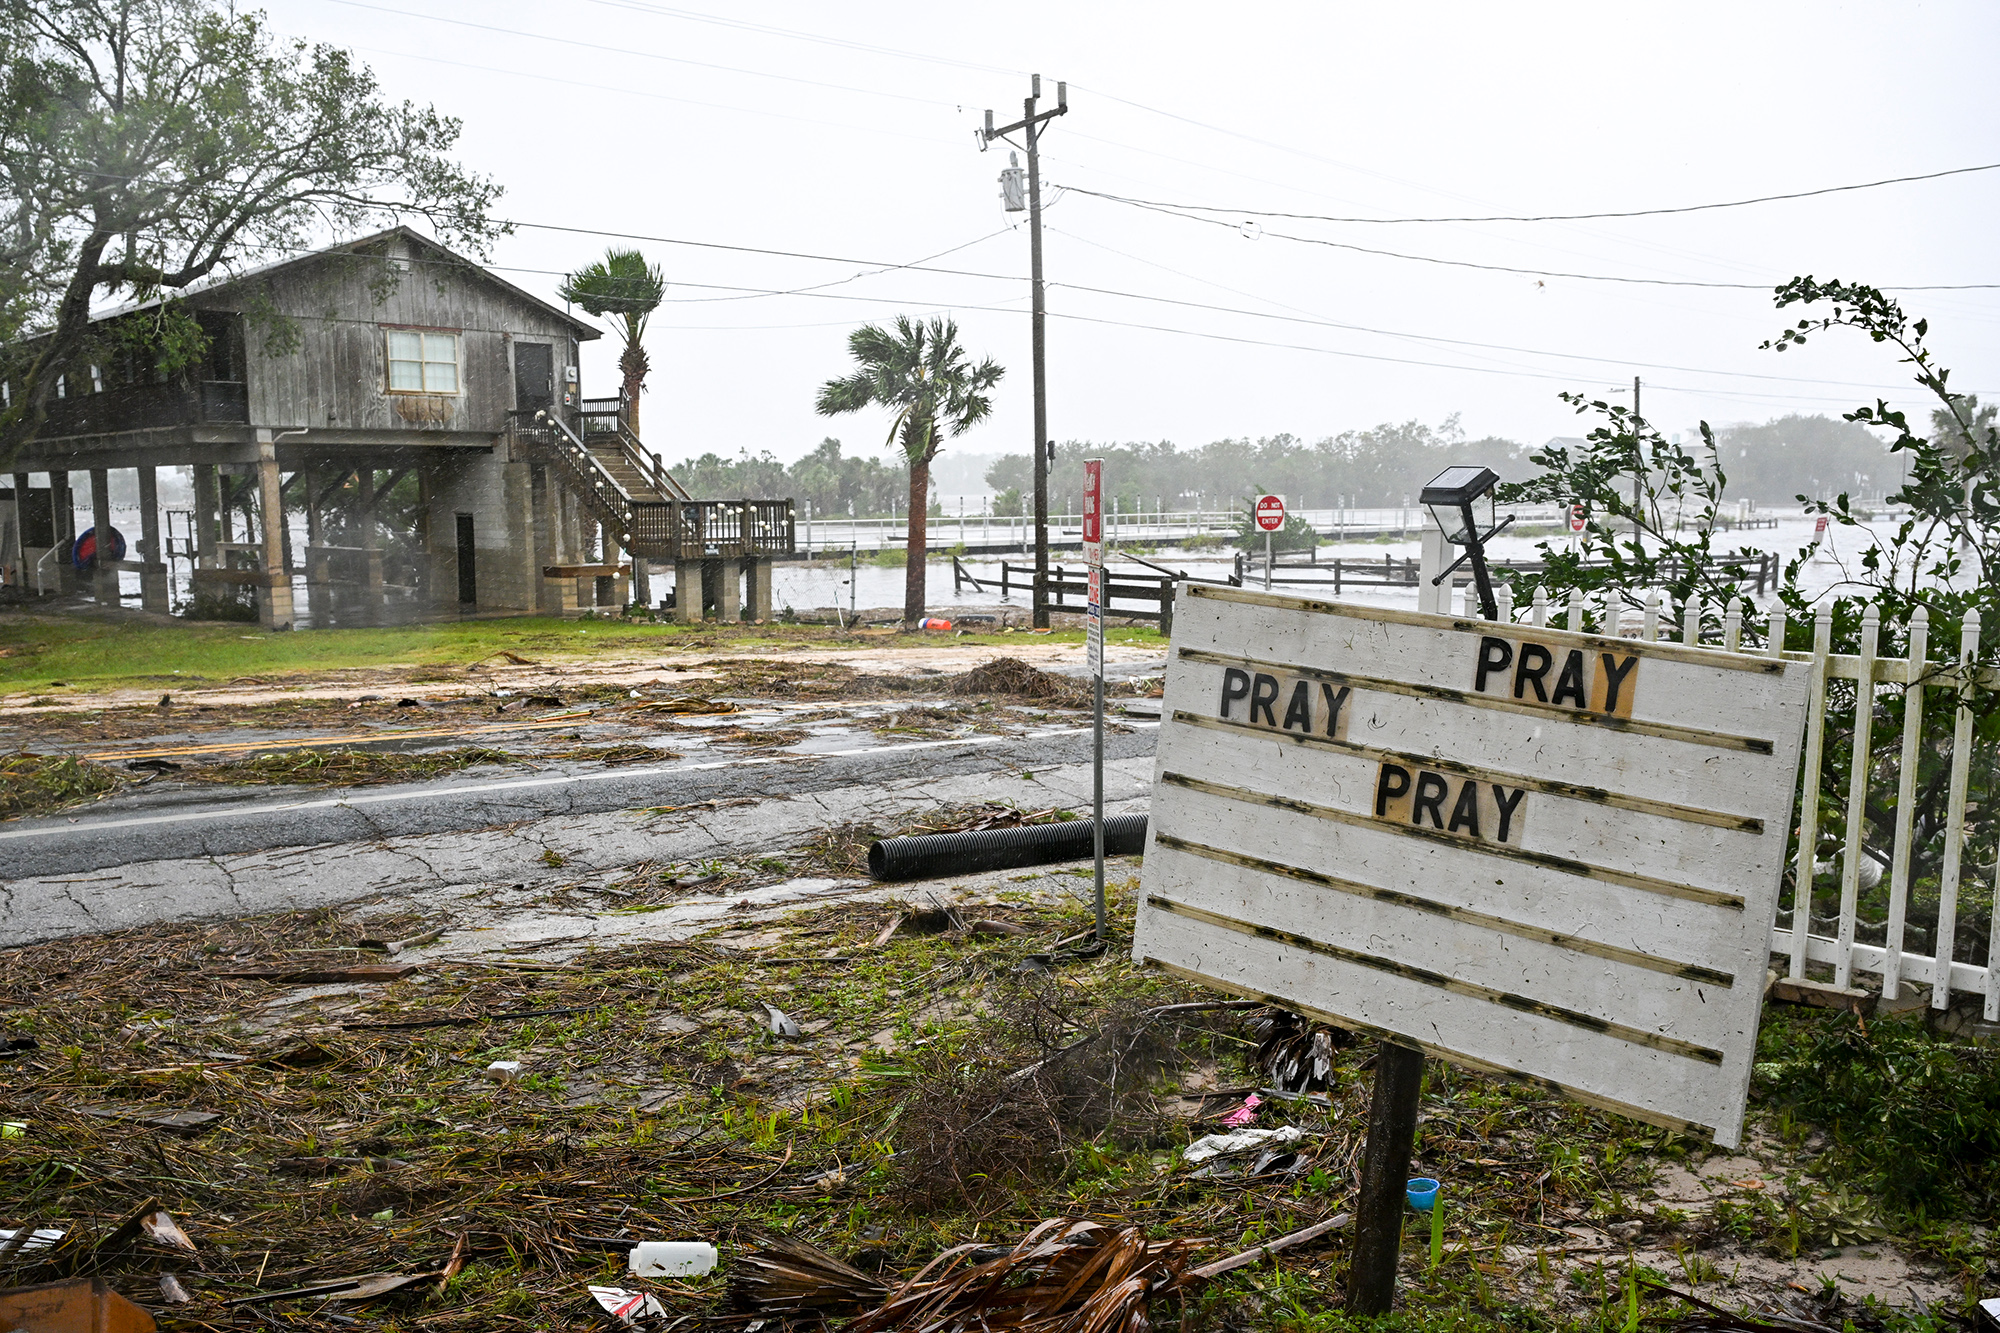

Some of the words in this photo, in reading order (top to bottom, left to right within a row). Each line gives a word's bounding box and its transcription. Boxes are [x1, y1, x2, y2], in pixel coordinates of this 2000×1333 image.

[1220, 667, 1351, 737] PRAY
[1475, 635, 1638, 712] PRAY
[1376, 763, 1526, 843] PRAY
